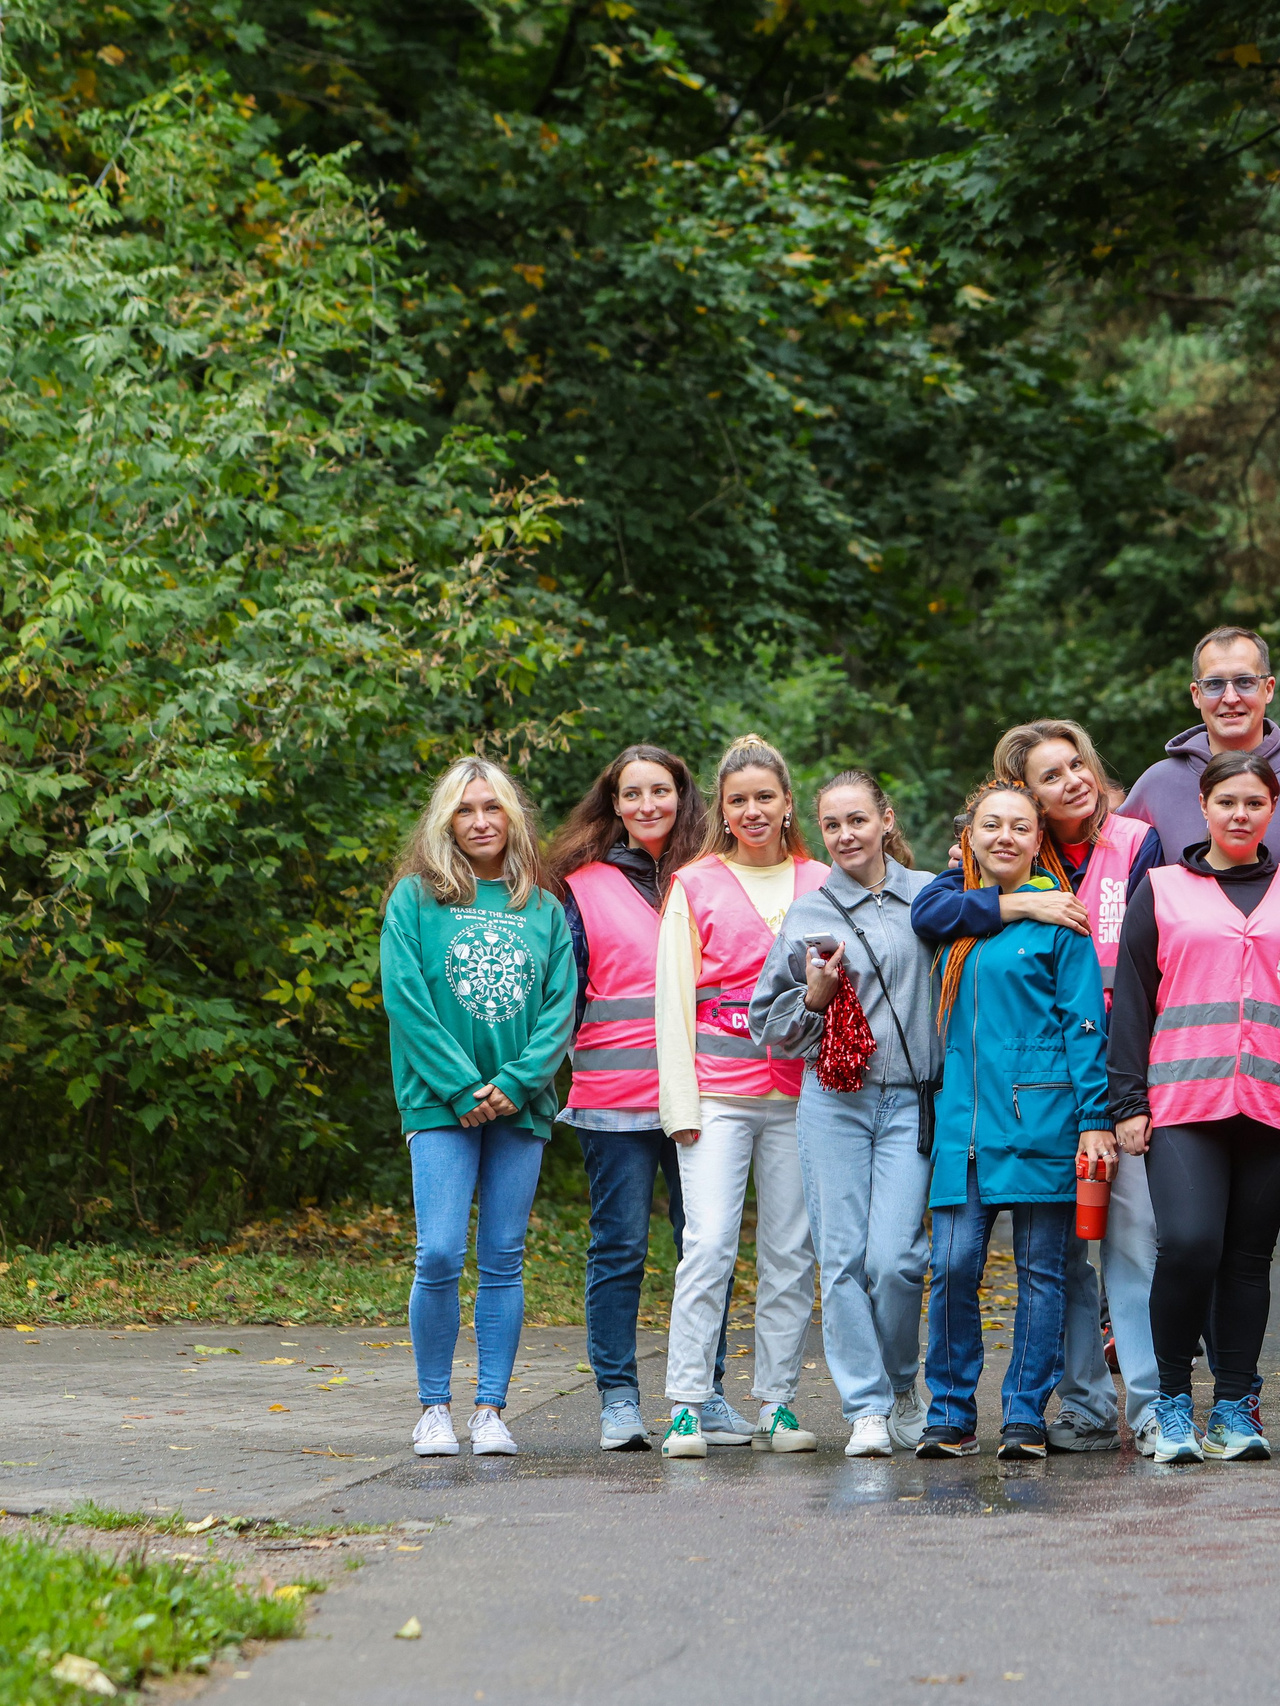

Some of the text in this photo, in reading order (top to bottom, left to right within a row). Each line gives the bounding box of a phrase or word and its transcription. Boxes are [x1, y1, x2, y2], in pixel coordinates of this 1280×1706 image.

[488, 910, 503, 918] THE
[504, 913, 527, 923] MOON
[1098, 922, 1122, 944] 5K
